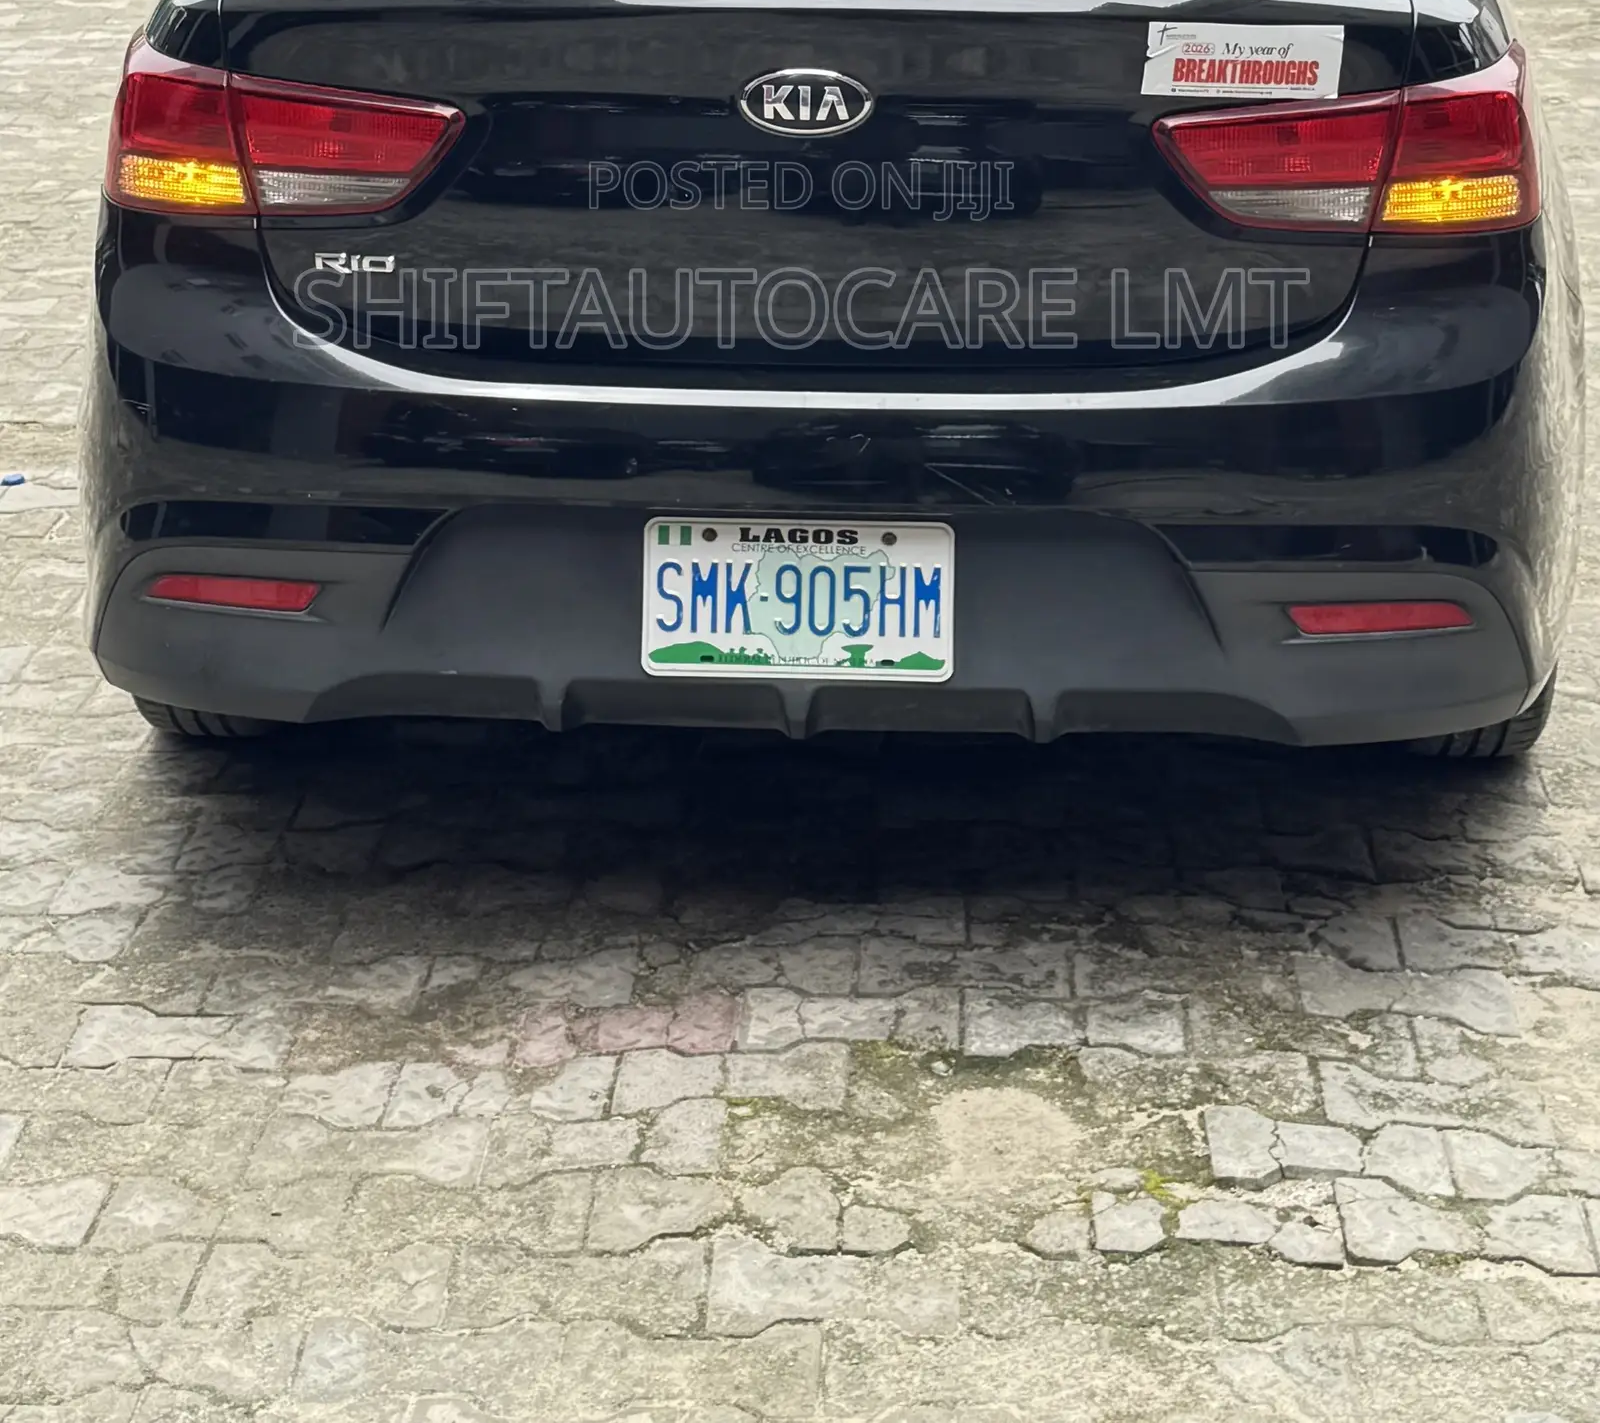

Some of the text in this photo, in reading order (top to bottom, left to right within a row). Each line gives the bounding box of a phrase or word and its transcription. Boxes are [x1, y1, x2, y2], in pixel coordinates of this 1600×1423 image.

[1221, 43, 1245, 57] My
[1249, 46, 1276, 58] year
[1277, 42, 1294, 58] of
[1172, 58, 1319, 86] BREAKTHROUGHS
[762, 85, 850, 121] KIA
[739, 527, 859, 545] LAGOS
[732, 543, 867, 555] CENTRE OF EXCELLENCE
